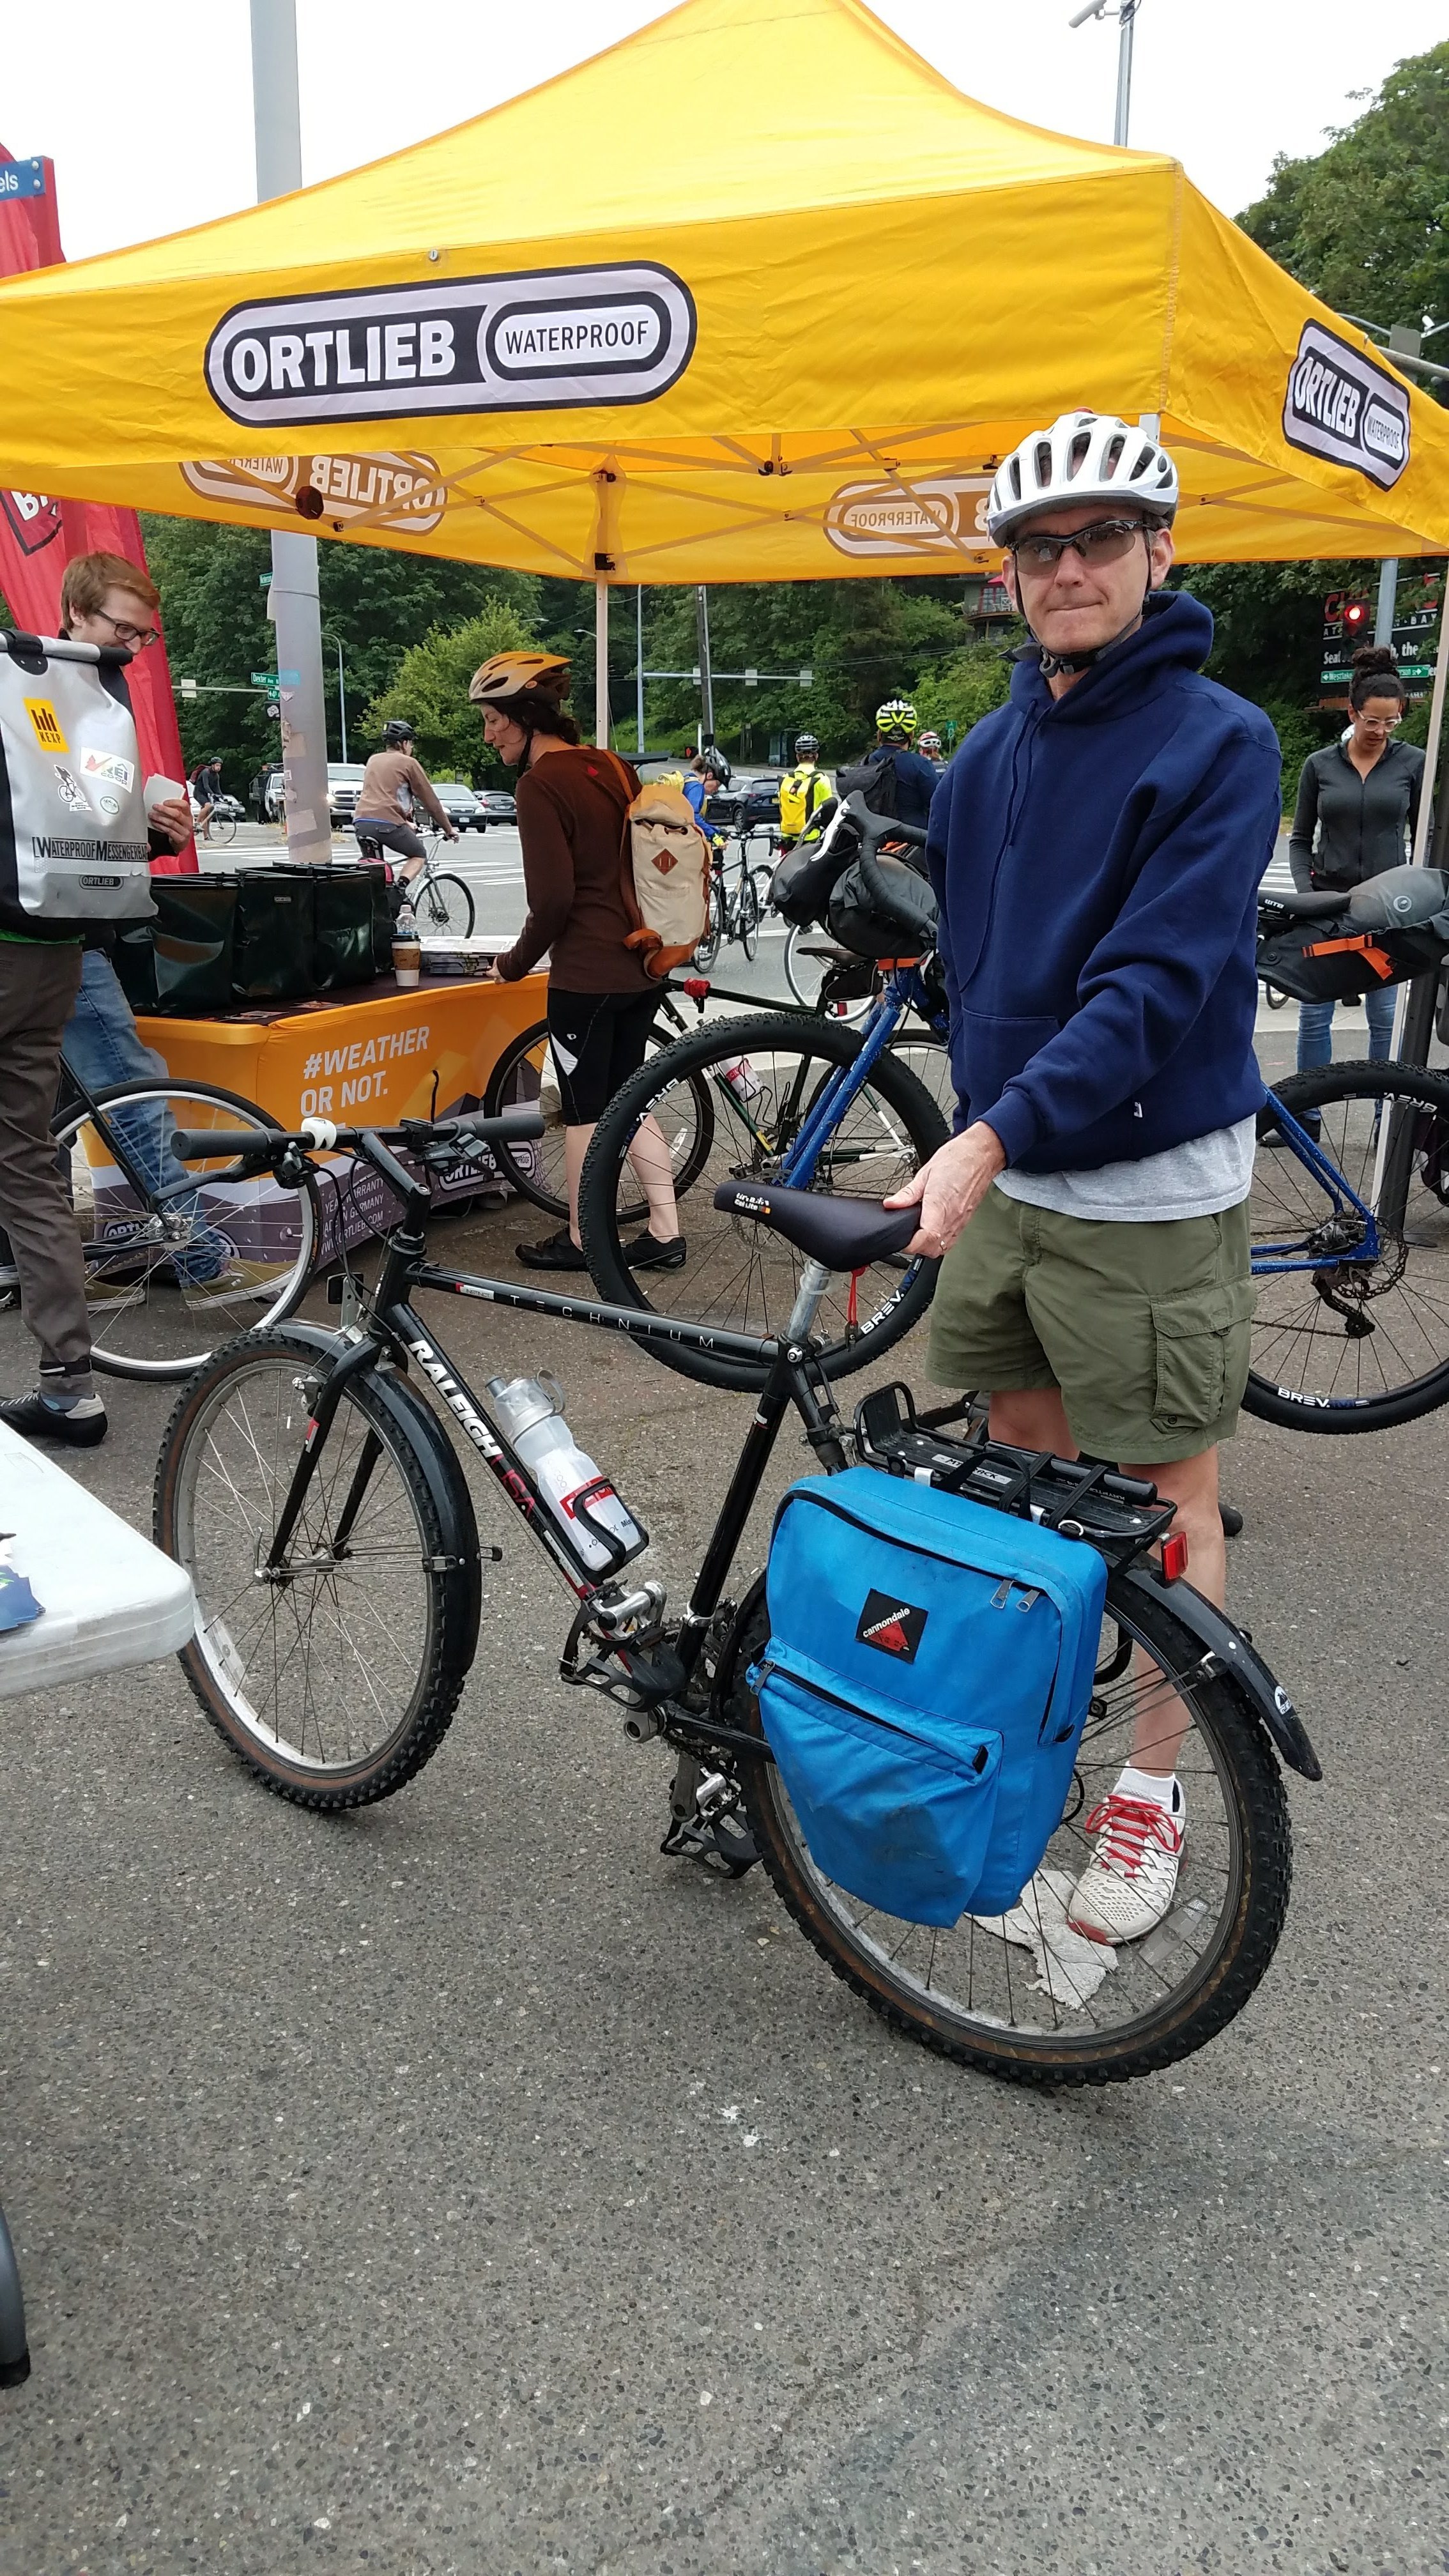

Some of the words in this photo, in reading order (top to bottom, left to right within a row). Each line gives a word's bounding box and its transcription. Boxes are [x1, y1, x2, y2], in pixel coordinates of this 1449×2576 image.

[231, 320, 456, 393] ORTLIEB
[505, 321, 648, 355] WATERPROOF
[1294, 356, 1361, 438] ORTLIEB
[38, 731, 61, 744] KEXP
[83, 877, 114, 885] ORTLIEB
[303, 1026, 430, 1079] #WEATHER
[300, 1086, 333, 1117] OR
[341, 1071, 388, 1108] NOT.
[510, 1294, 714, 1349] TECHNIUM
[860, 1289, 905, 1335] BREV.
[408, 1339, 503, 1459] RALEIGH
[1278, 1386, 1330, 1408] BREV.
[862, 1607, 910, 1638] cannondale
